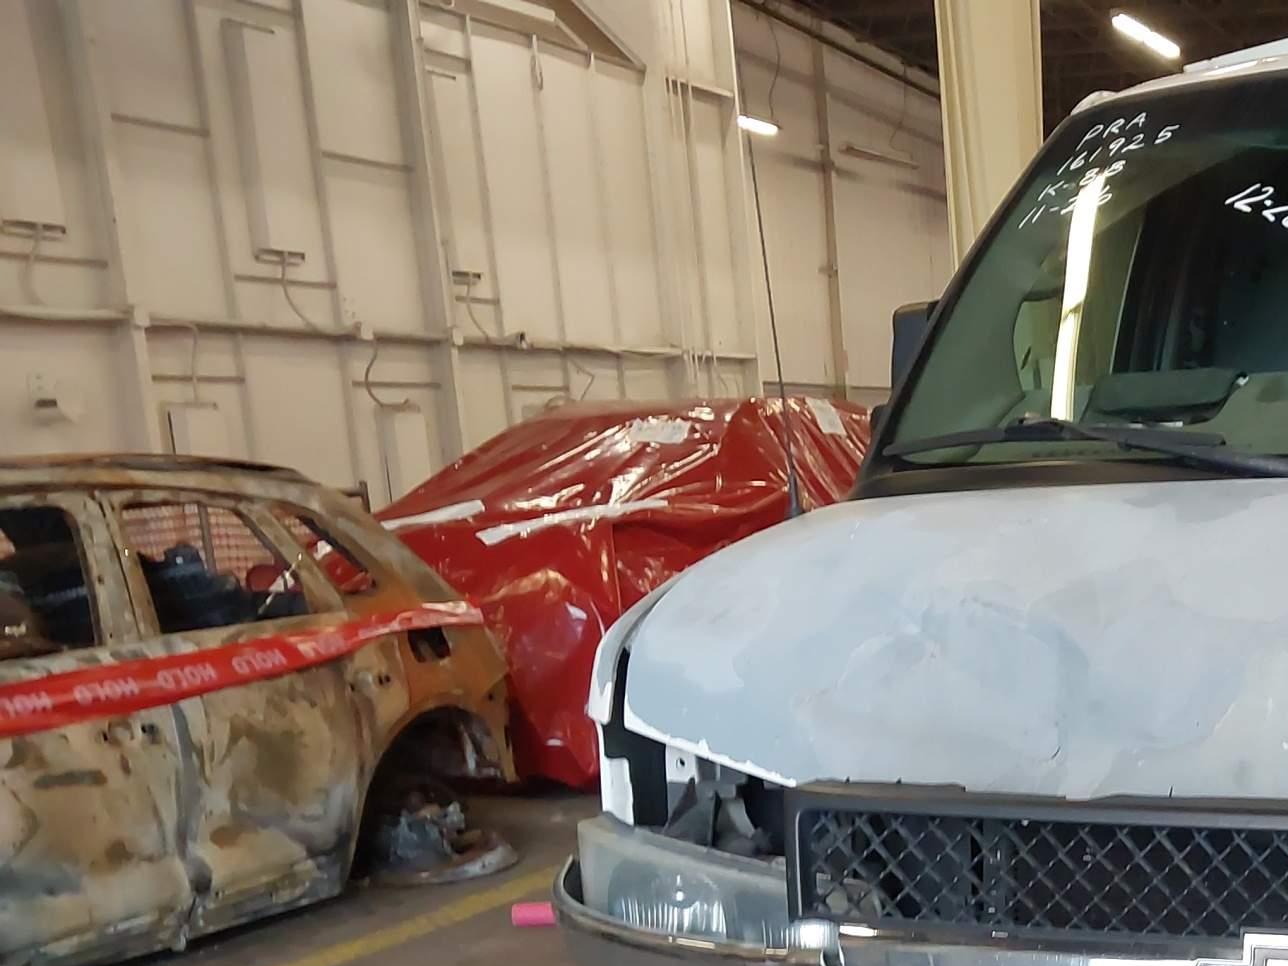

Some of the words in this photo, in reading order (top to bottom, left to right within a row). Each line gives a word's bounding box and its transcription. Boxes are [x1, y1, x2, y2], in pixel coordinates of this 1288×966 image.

[1075, 112, 1147, 151] PRA
[231, 648, 287, 674] HOLD
[156, 662, 218, 689] HOLD
